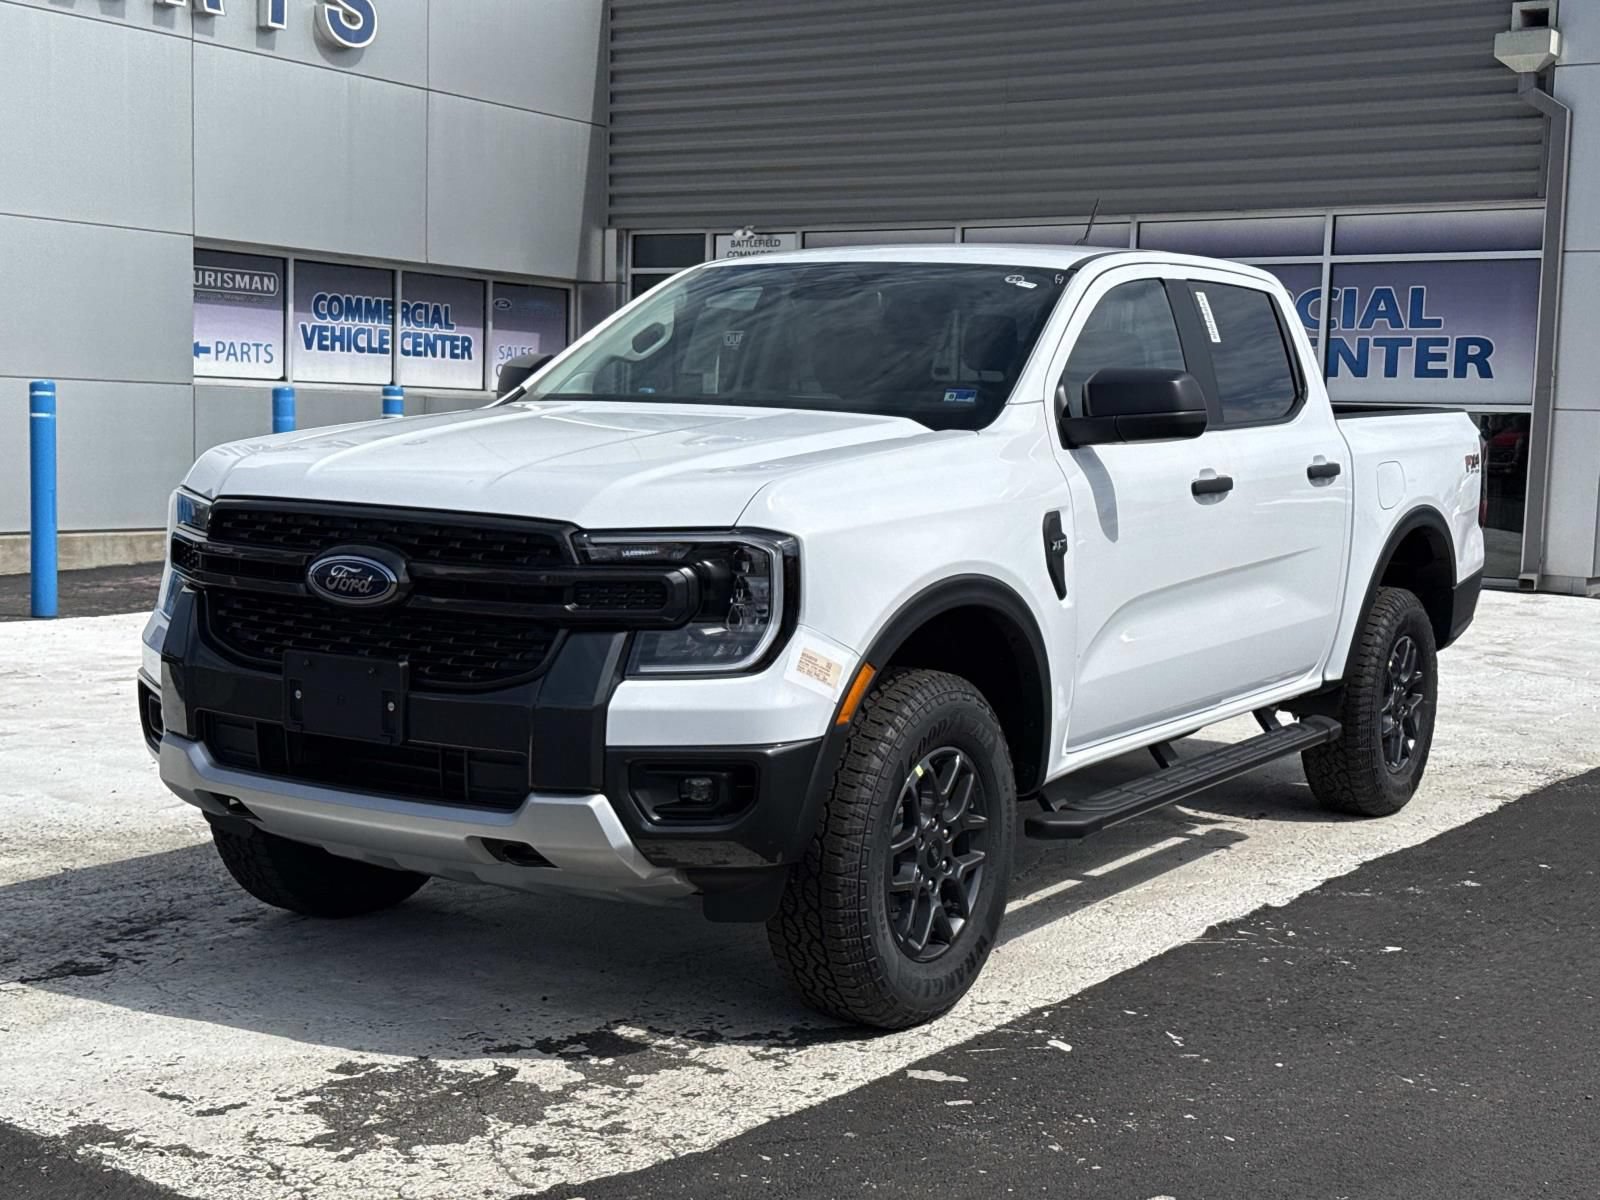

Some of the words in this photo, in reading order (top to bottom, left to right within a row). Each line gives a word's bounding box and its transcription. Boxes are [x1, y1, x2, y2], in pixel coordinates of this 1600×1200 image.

[730, 239, 781, 248] BATTLEFIELD
[193, 270, 275, 292] URISMAN
[312, 292, 456, 332] COMMERCIAL
[1291, 286, 1443, 331] CIAL
[214, 340, 274, 364] PARTS
[299, 323, 392, 356] VEHICLE
[400, 330, 474, 361] CENTER
[1316, 336, 1495, 379] NTER
[325, 564, 374, 594] Ford
